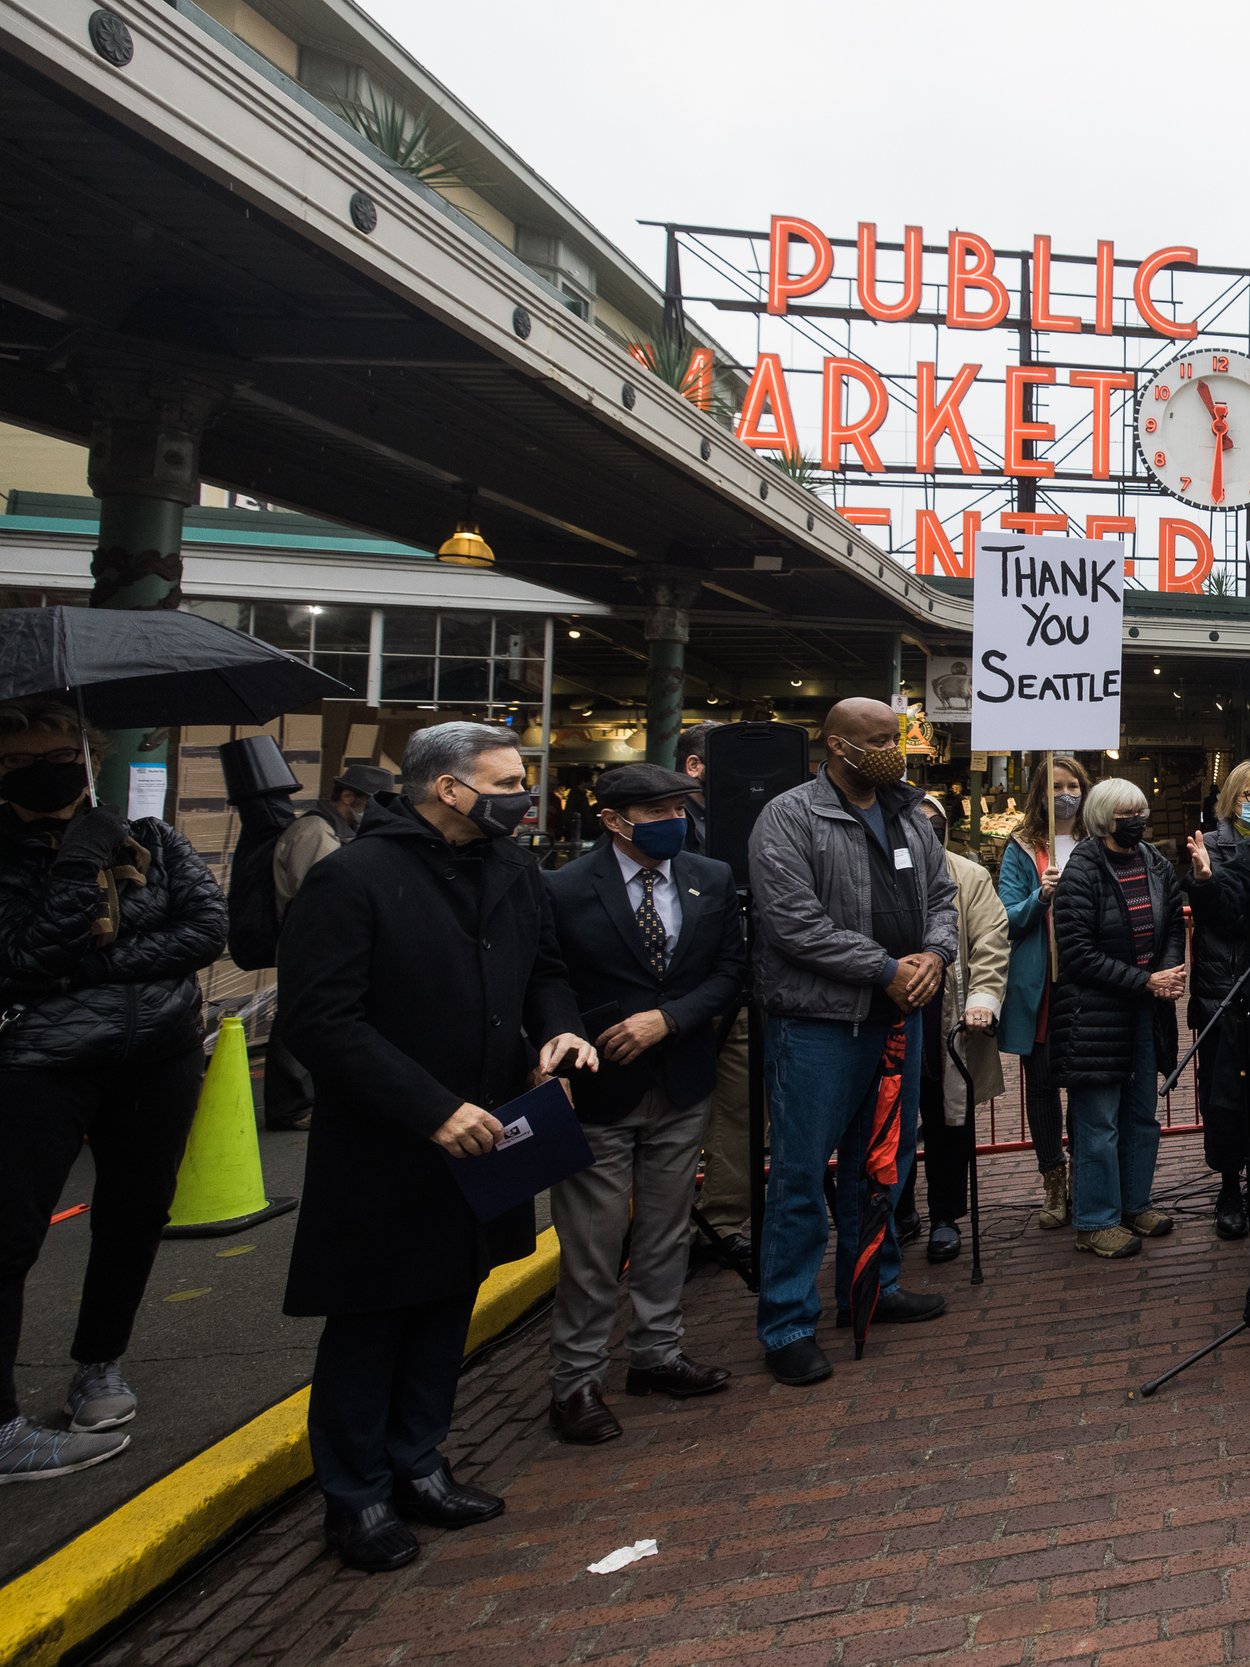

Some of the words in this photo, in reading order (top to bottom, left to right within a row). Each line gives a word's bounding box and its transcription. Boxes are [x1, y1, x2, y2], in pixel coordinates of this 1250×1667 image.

[766, 214, 1198, 340] PUBLIC
[1180, 363, 1193, 379] 11
[1212, 356, 1229, 372] 12
[1154, 385, 1171, 401] 10
[1145, 418, 1157, 433] 9
[1154, 451, 1166, 467] 8
[1180, 476, 1192, 492] 7
[981, 545, 1121, 603] THANK
[1021, 602, 1089, 647] YOU
[977, 650, 1120, 703] SEATTLE
